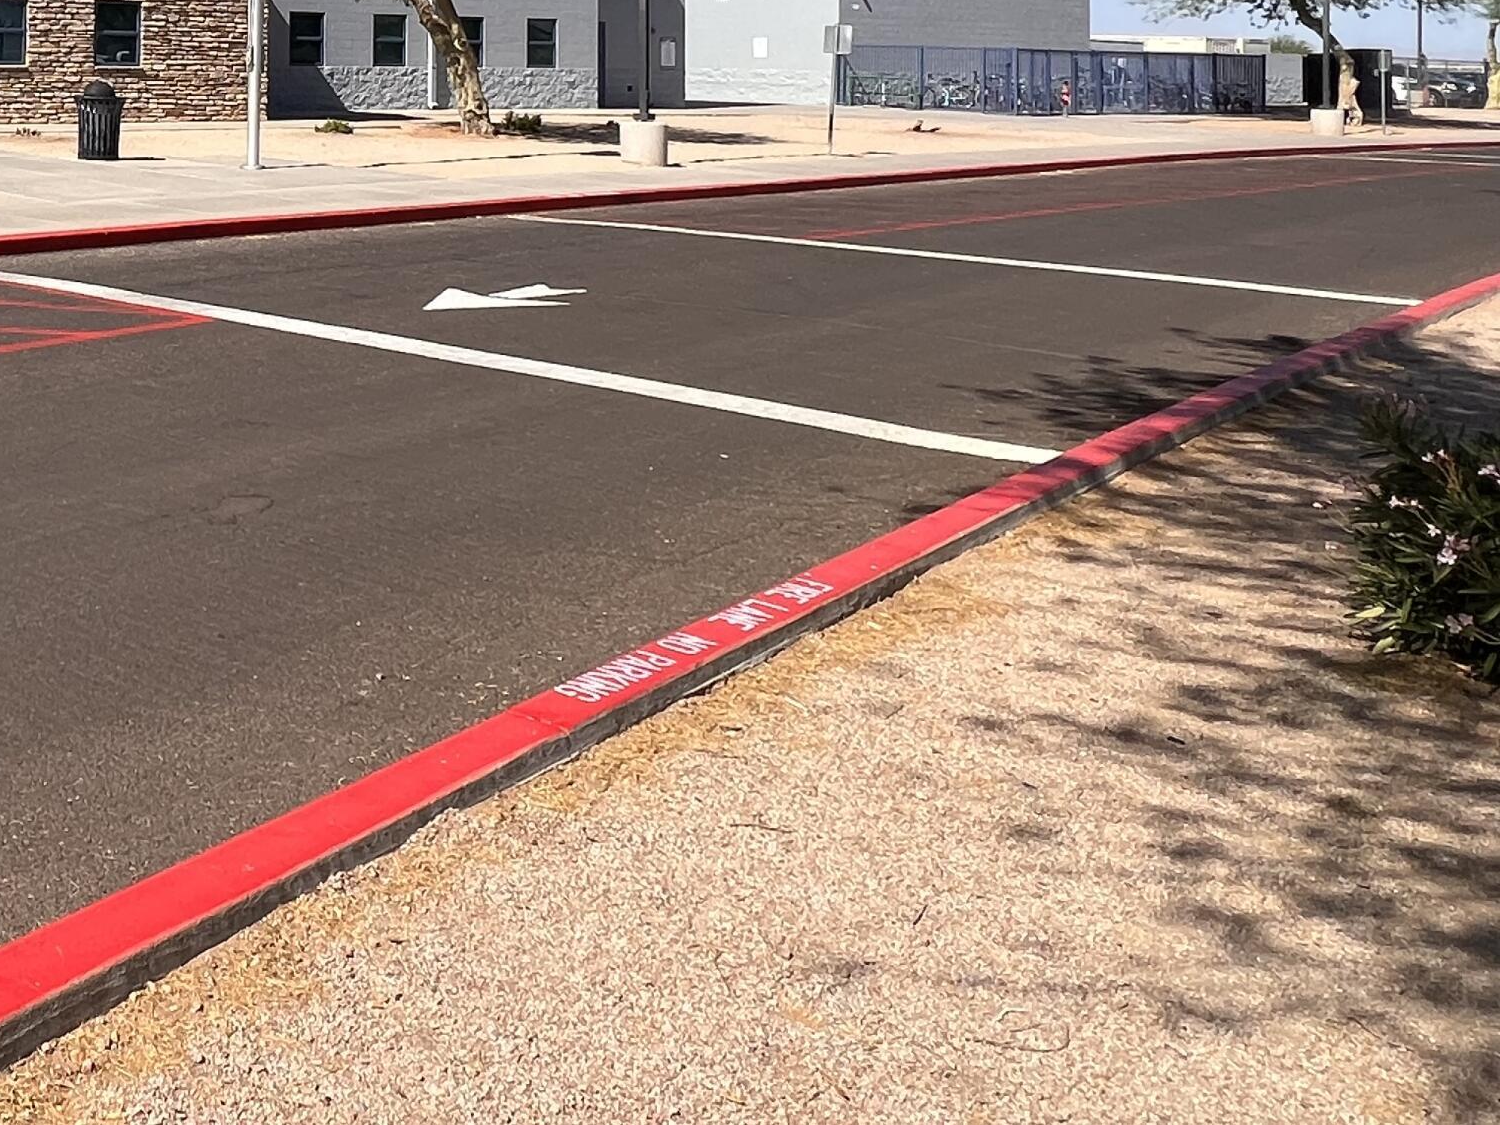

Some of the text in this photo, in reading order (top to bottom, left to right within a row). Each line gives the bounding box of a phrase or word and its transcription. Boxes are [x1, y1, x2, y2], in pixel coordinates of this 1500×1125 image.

[707, 598, 789, 632] LANE
[656, 631, 717, 655] NO
[554, 649, 677, 703] PARKING
